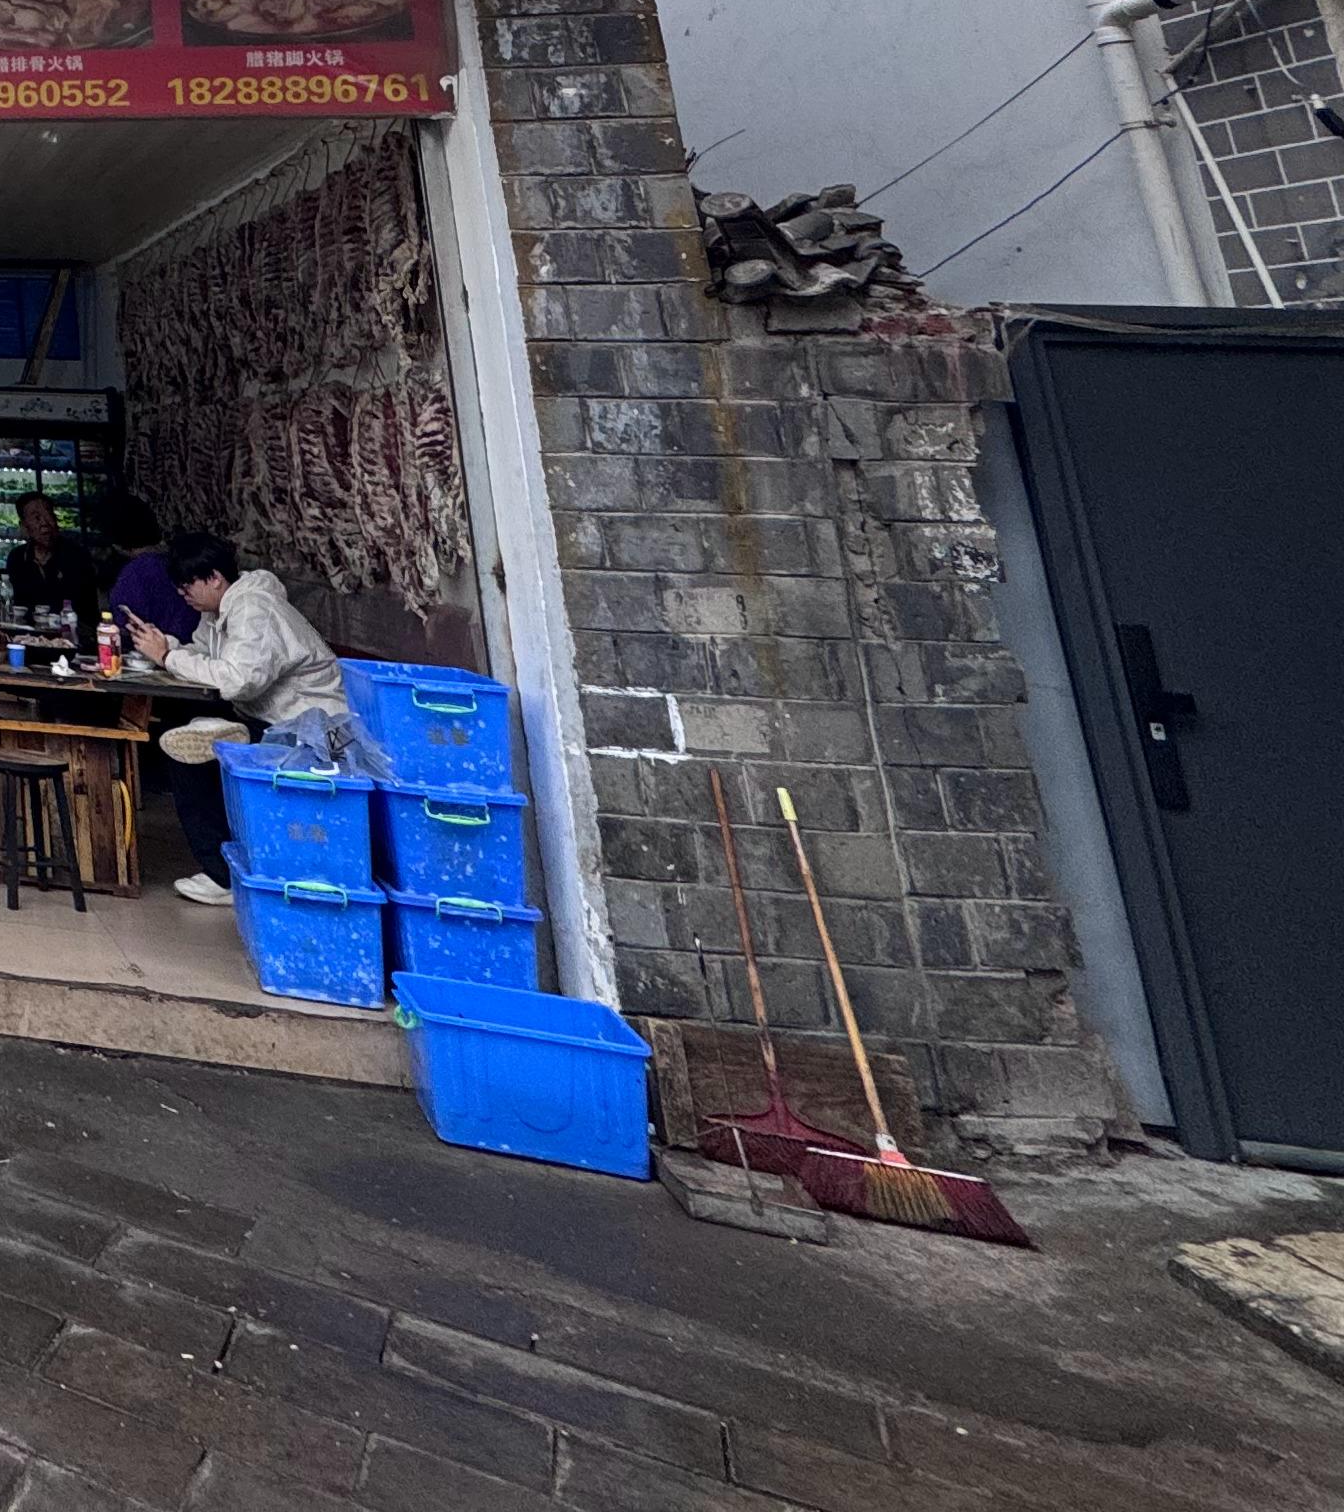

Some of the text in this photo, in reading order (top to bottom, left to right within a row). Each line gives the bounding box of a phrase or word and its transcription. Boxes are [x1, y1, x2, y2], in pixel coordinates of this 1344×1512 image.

[245, 48, 345, 68] 腊猪脚火锅
[167, 73, 431, 105] 18288896761
